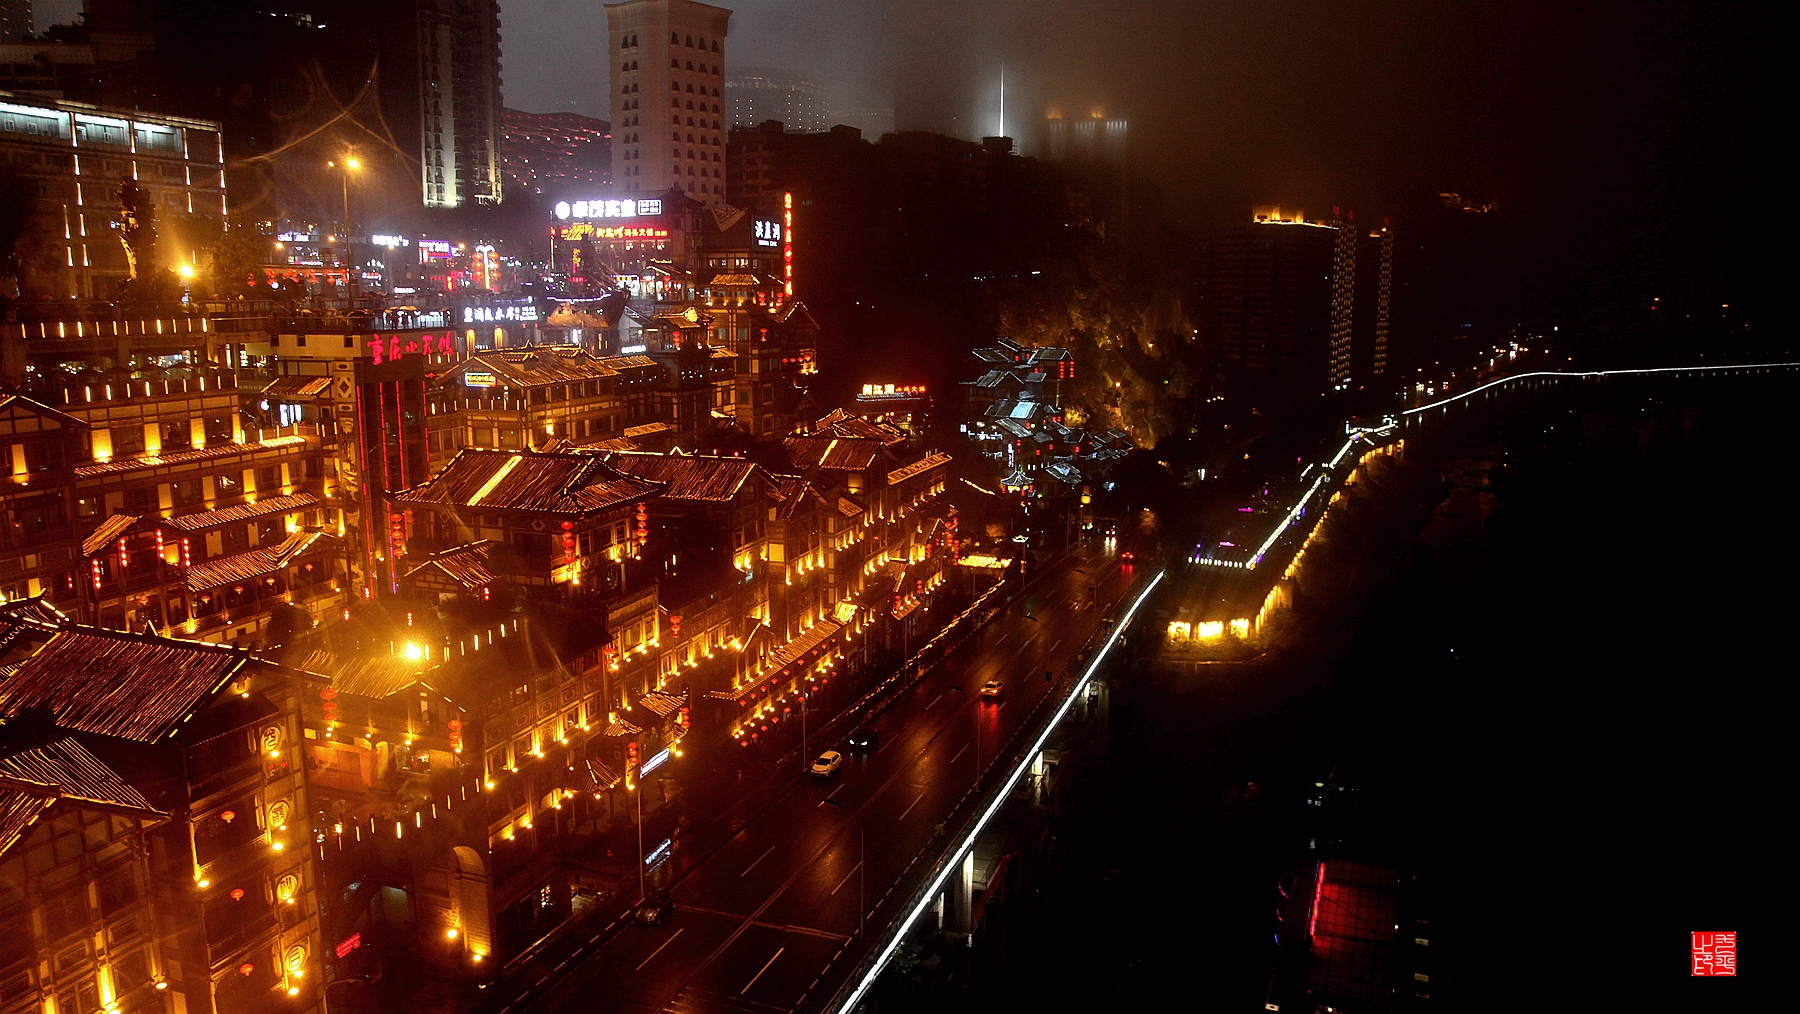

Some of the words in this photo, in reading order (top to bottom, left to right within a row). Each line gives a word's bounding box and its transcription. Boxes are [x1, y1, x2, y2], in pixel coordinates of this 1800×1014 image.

[366, 331, 454, 366] 重庆小天鹅
